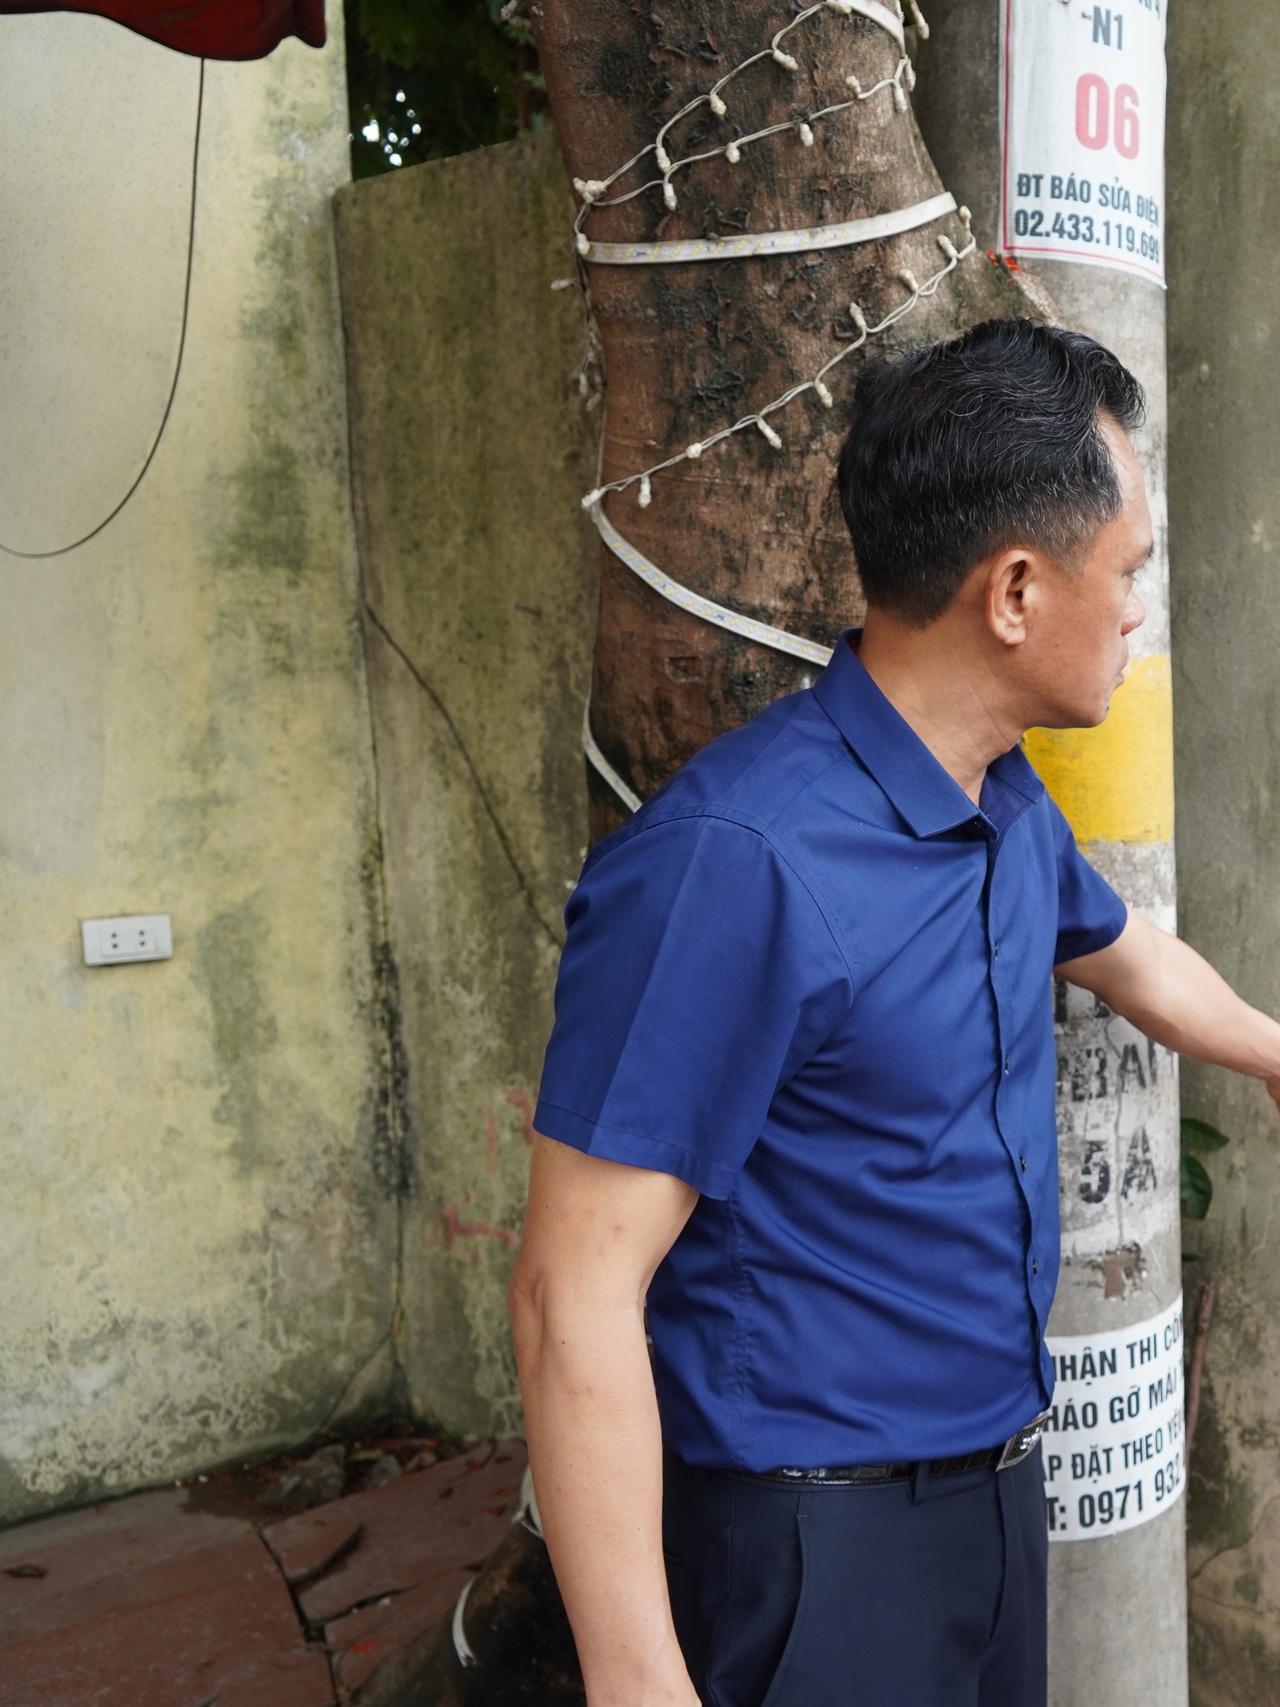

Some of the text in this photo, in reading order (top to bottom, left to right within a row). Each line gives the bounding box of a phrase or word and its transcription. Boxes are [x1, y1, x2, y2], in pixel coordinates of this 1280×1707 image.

[1075, 73, 1140, 160] 06
[1017, 173, 1044, 198] ĐT
[1050, 172, 1091, 203] BÁO
[1098, 176, 1131, 216] SỬA
[1126, 1332, 1157, 1370] THI
[1109, 1385, 1141, 1424] GỠ
[1071, 1444, 1114, 1484] ĐẶT
[1121, 1428, 1164, 1469] THEO
[1078, 1479, 1144, 1529] 0971
[1155, 1453, 1181, 1502] 932
